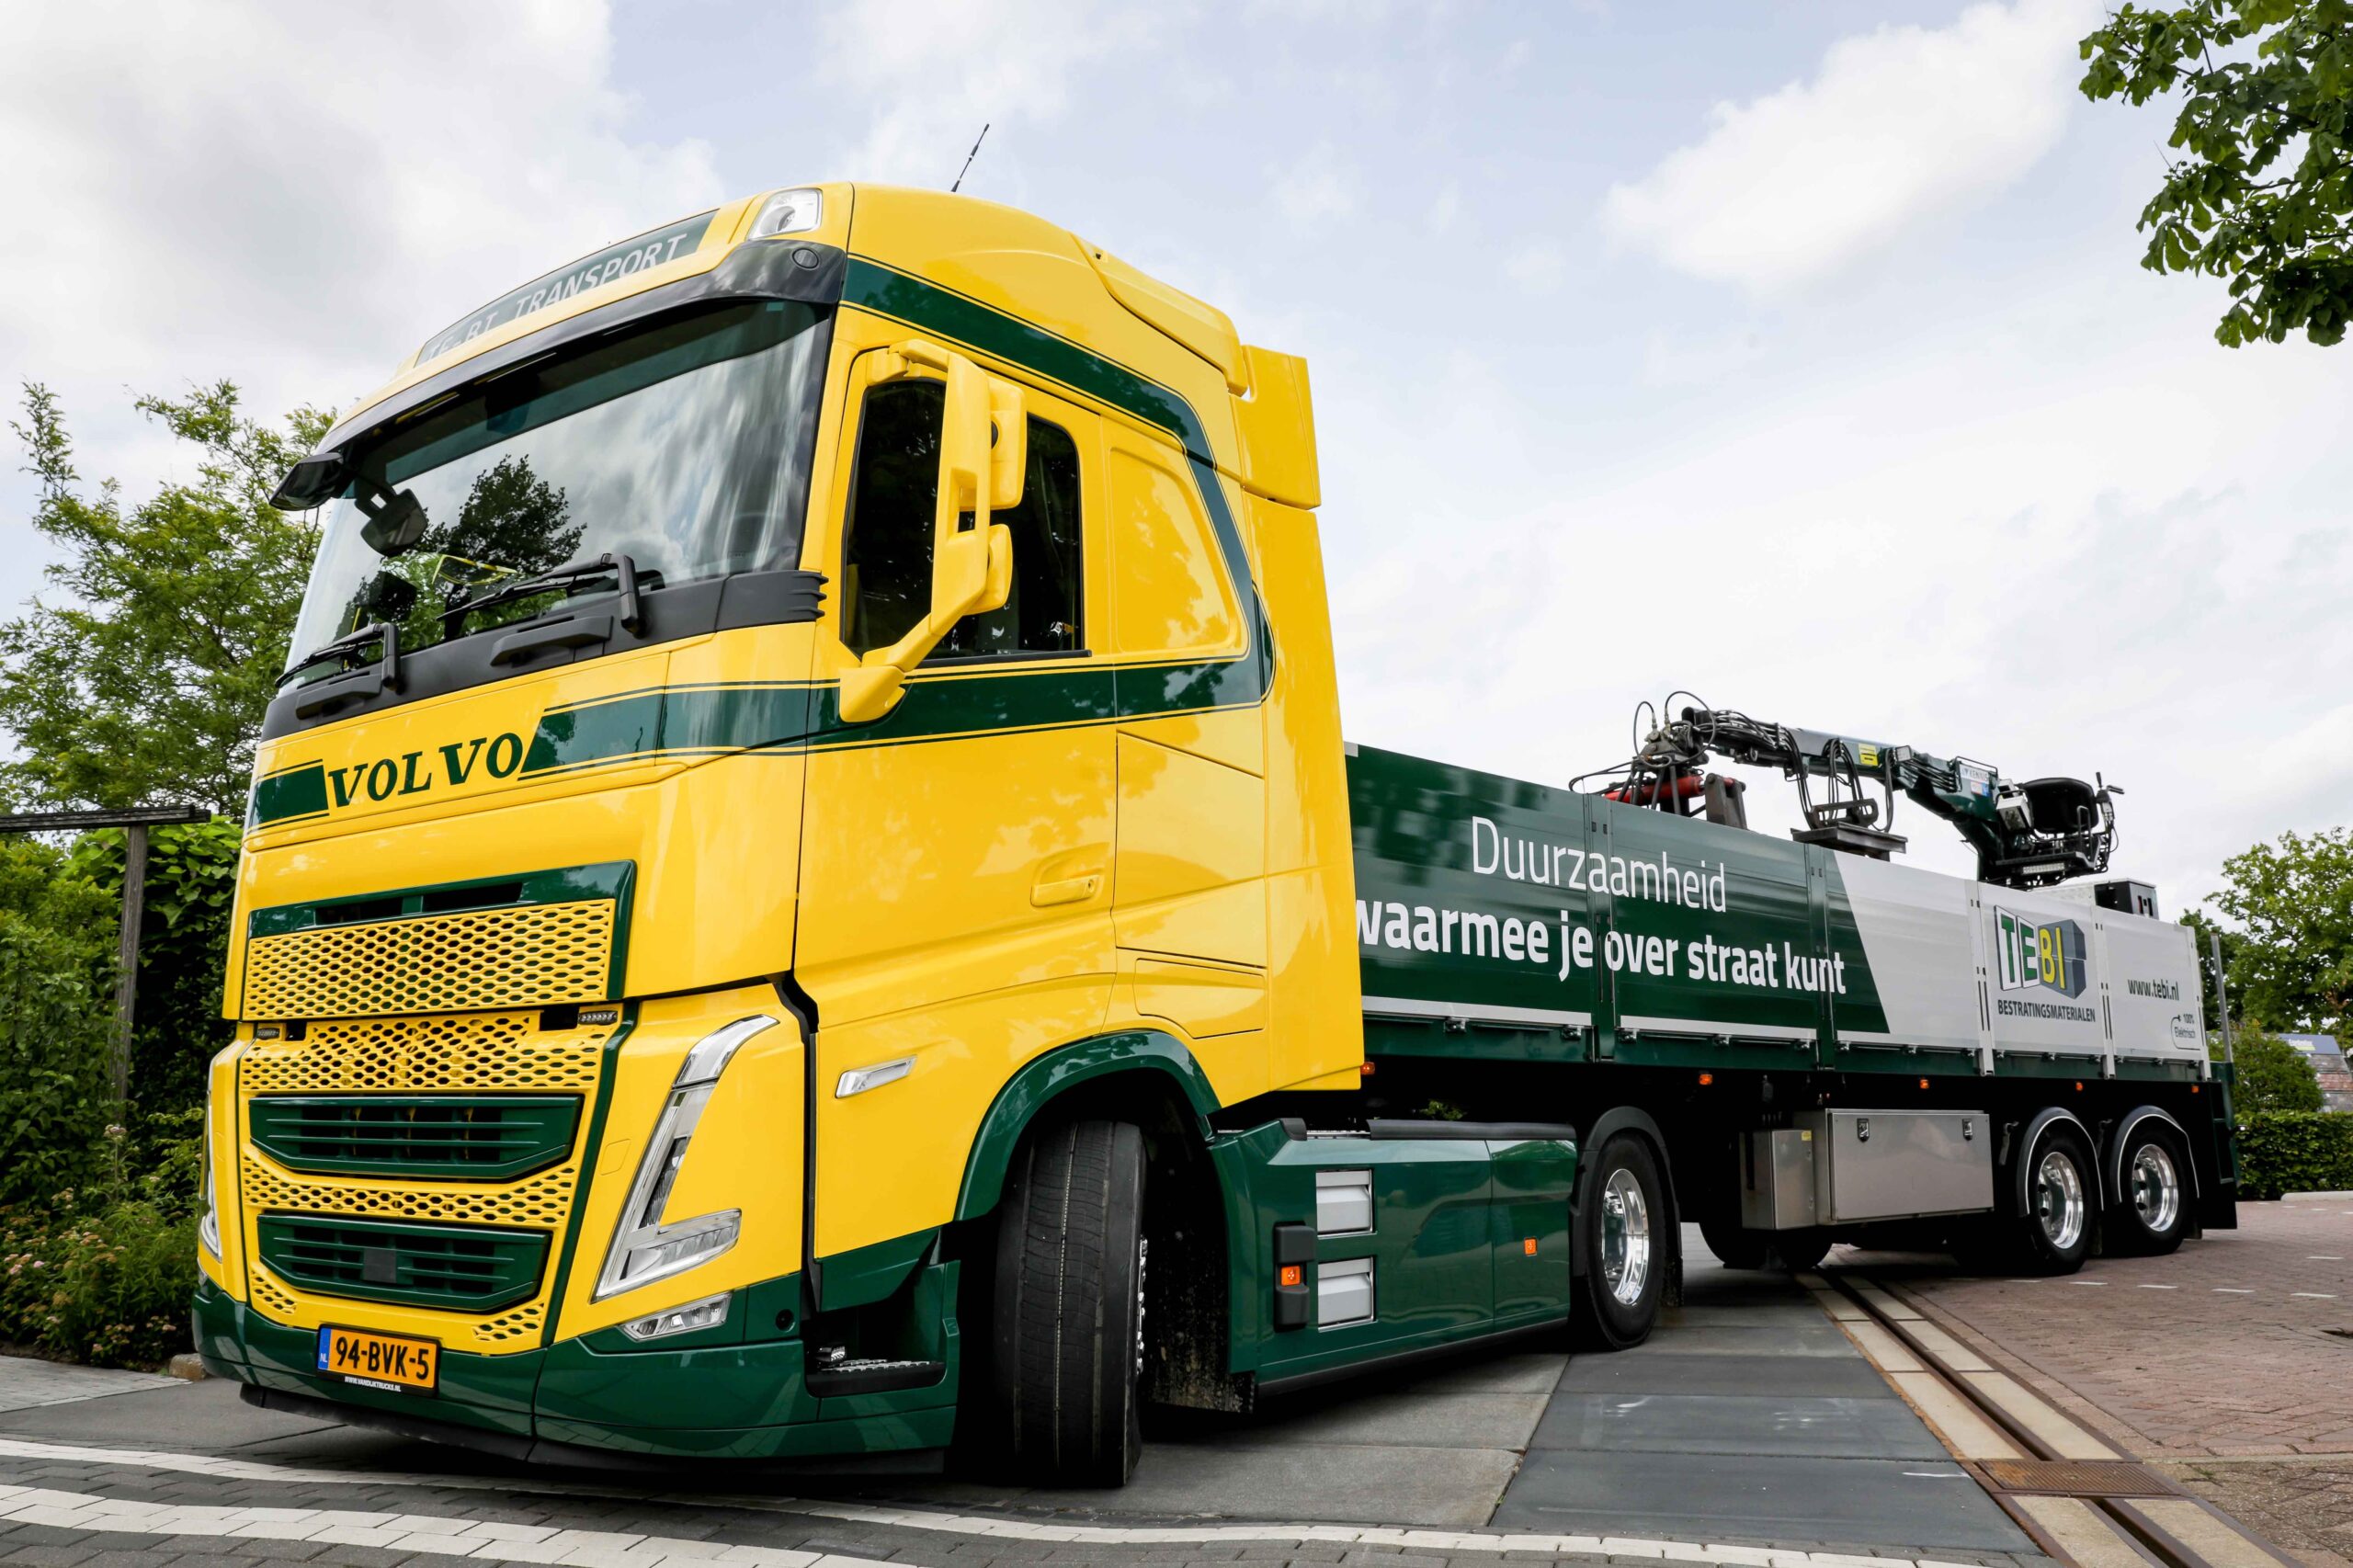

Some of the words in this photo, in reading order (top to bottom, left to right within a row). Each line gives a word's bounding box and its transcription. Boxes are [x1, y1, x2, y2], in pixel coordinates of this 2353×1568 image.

[515, 233, 688, 320] TRANSPORT
[327, 732, 524, 808] VOLVO
[1471, 815, 1727, 913] Duurzaamheid
[1356, 899, 1549, 963] waarmee
[1558, 909, 1594, 983] je
[1604, 930, 1679, 977] over
[1688, 934, 1779, 988] straat
[1784, 941, 1847, 994] kunt
[1997, 908, 2067, 990] TEBI
[1997, 999, 2096, 1022] BESTRATINGSMATERIALEN
[2127, 979, 2180, 1001] www.tebi.nl
[320, 1352, 328, 1363] NL
[335, 1335, 430, 1381] 94-BVK-5
